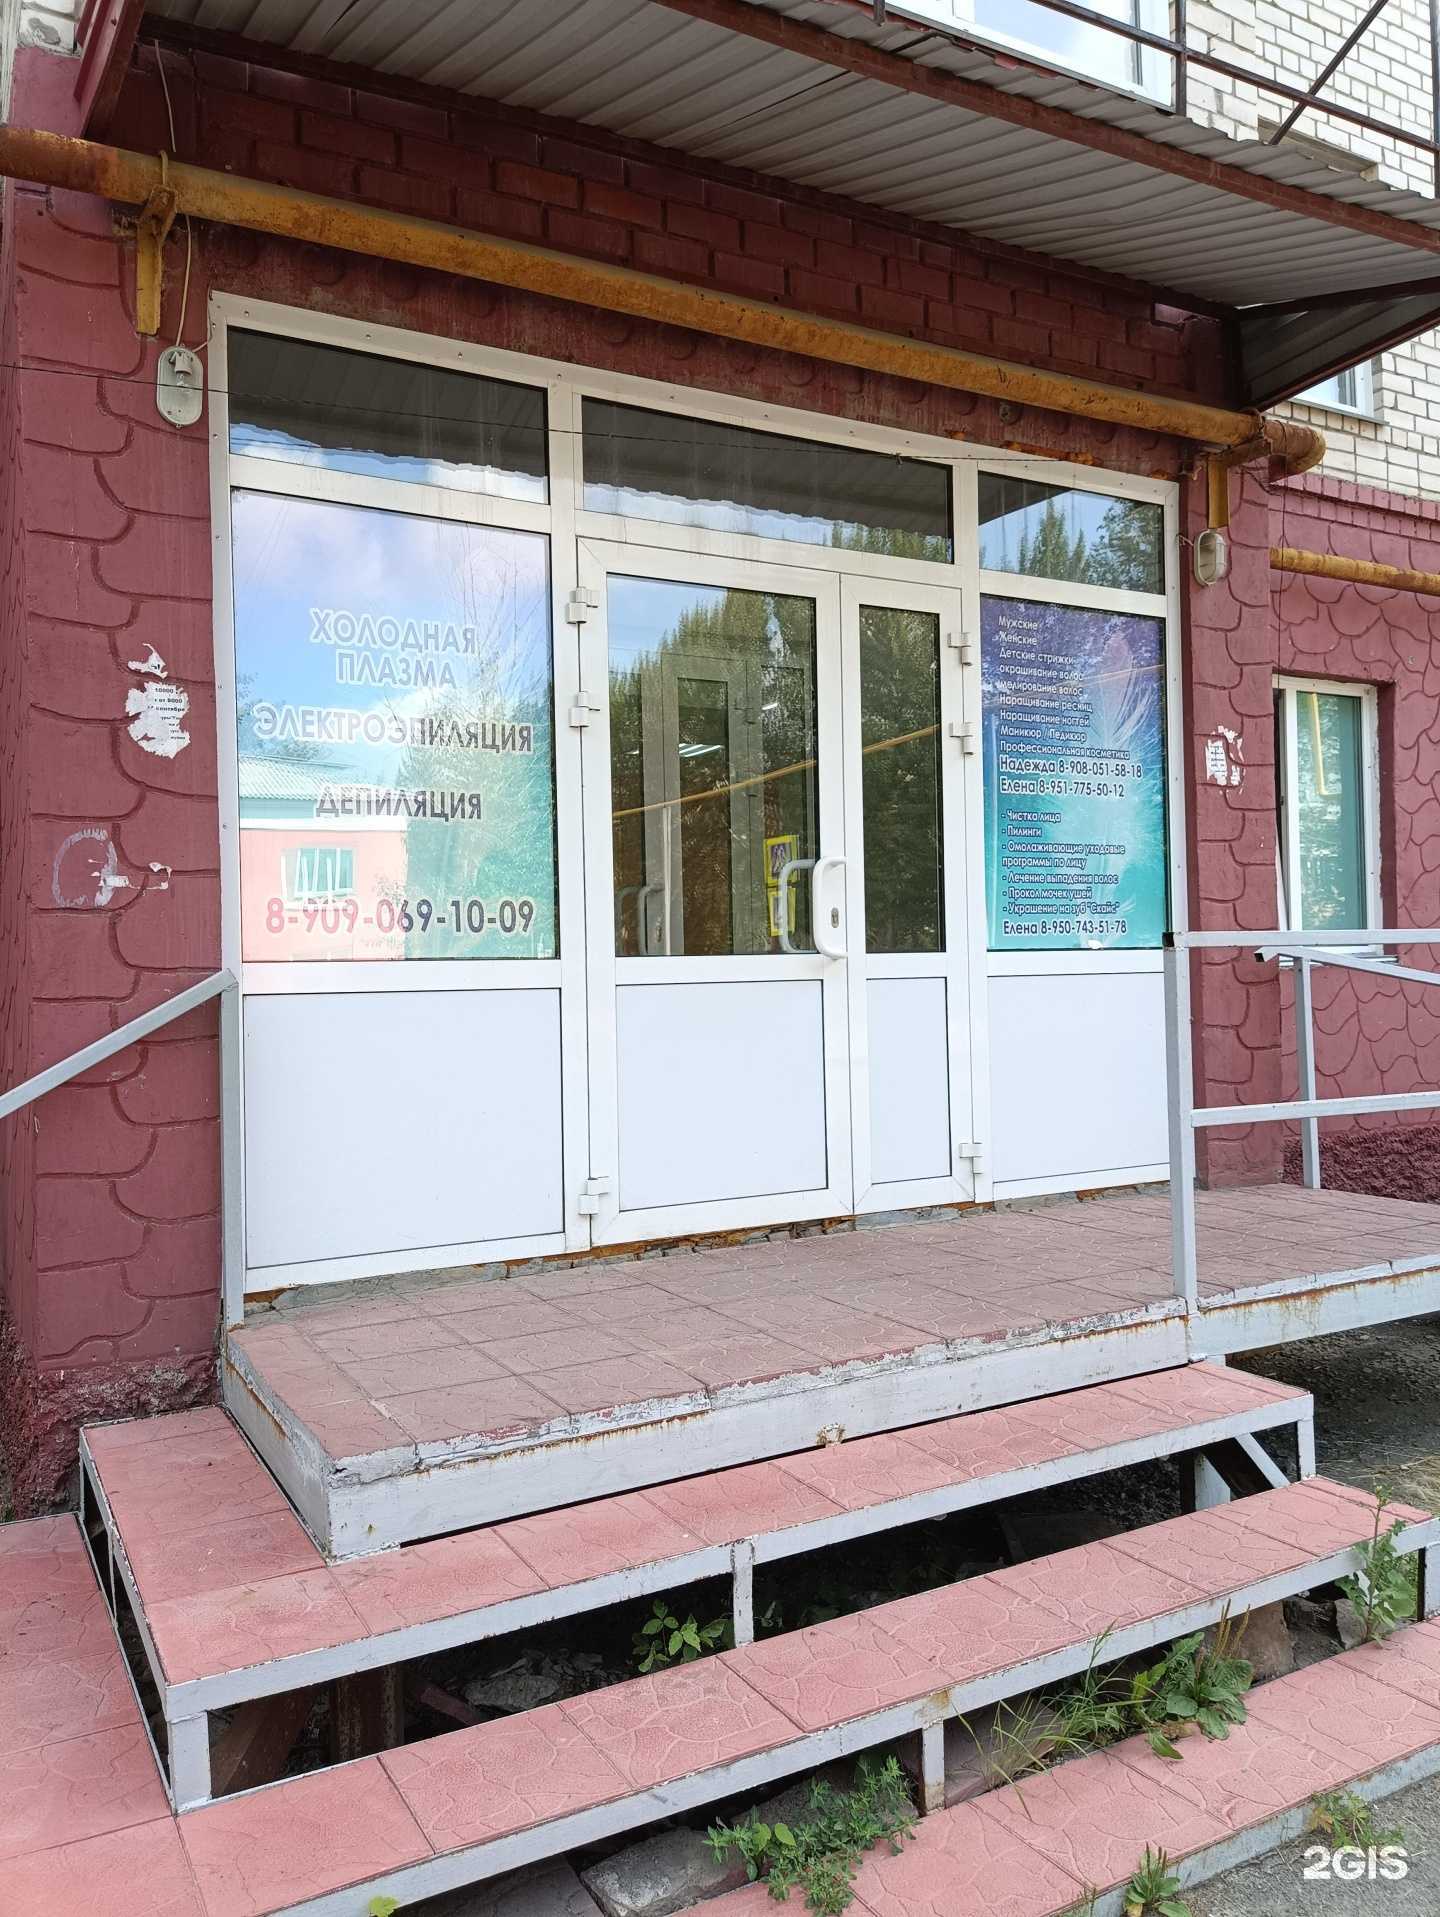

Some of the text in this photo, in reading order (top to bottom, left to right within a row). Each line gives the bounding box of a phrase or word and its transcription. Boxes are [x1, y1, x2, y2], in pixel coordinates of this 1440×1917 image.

[998, 615, 1038, 630] Мужские
[312, 611, 476, 653] ХОЛОДНАЯ
[1000, 631, 1038, 645] Женские
[1000, 648, 1074, 665] Детские стрижки
[337, 653, 456, 688] ПЛАЗМА
[999, 664, 1083, 681] окрашивание волос
[1000, 681, 1084, 696] мелирование волос
[1000, 693, 1093, 712] Наращивание ресниц
[1000, 709, 1090, 727] Наращивание ногтей
[254, 705, 532, 753] ЭЛЕКТРОЭПИЛЯЦИЯ
[1000, 725, 1042, 738] Маникюр
[1049, 729, 1087, 744] Педикюр
[1000, 740, 1130, 760] Профессиональная косметика
[1000, 755, 1142, 778] Надежда 8-908-051-58-18
[1001, 777, 1124, 798] Елена 8-951-775-50-12
[315, 786, 482, 822] ДЕПИЛЯЦИЯ
[1007, 810, 1061, 823] Чистка лица
[1007, 825, 1042, 837] Пилинги
[1008, 841, 1126, 856] Омолаживающие уходовые
[1002, 858, 1087, 870] программы по лицу
[1008, 871, 1119, 885] Лечение выпадения волос
[1008, 887, 1092, 900] Прокол мочек ушей
[265, 897, 534, 935] 8-909-069-10-09
[1008, 902, 1057, 915] Украшение
[1059, 905, 1070, 913] на
[1071, 903, 1086, 915] зуб
[1003, 920, 1127, 935] Елена 8-950-743-51-78
